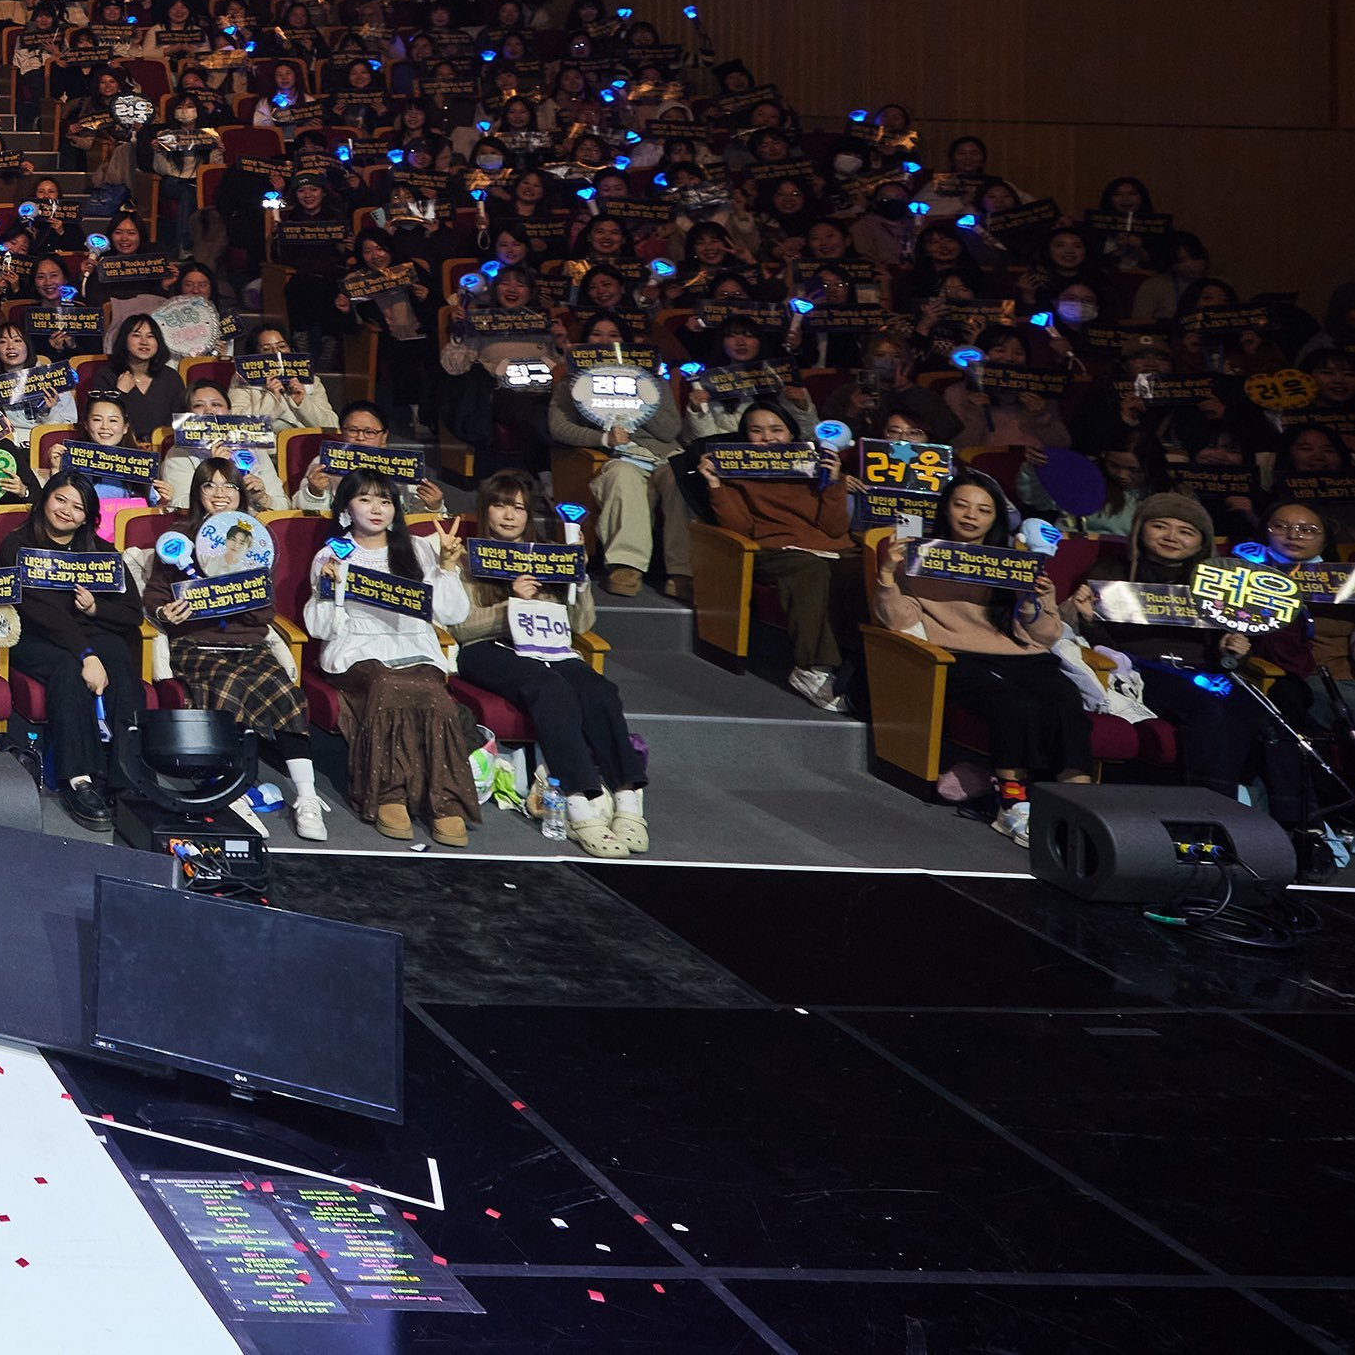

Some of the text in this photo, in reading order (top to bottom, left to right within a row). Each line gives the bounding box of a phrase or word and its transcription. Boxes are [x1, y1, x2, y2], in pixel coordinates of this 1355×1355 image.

[70, 448, 94, 459] 내인생
[96, 451, 126, 465] "Rucky
[72, 458, 149, 475] 너의 노래가 있는 지금
[867, 450, 949, 492] 려욱
[479, 547, 507, 558] 내인생
[509, 549, 546, 562] "Rucky
[956, 550, 999, 567] "Rucky
[482, 558, 575, 574] 너의 노래가 있는 지금
[922, 559, 1035, 584] 너의 노래가 있는 지금
[1189, 563, 1300, 623] 려욱
